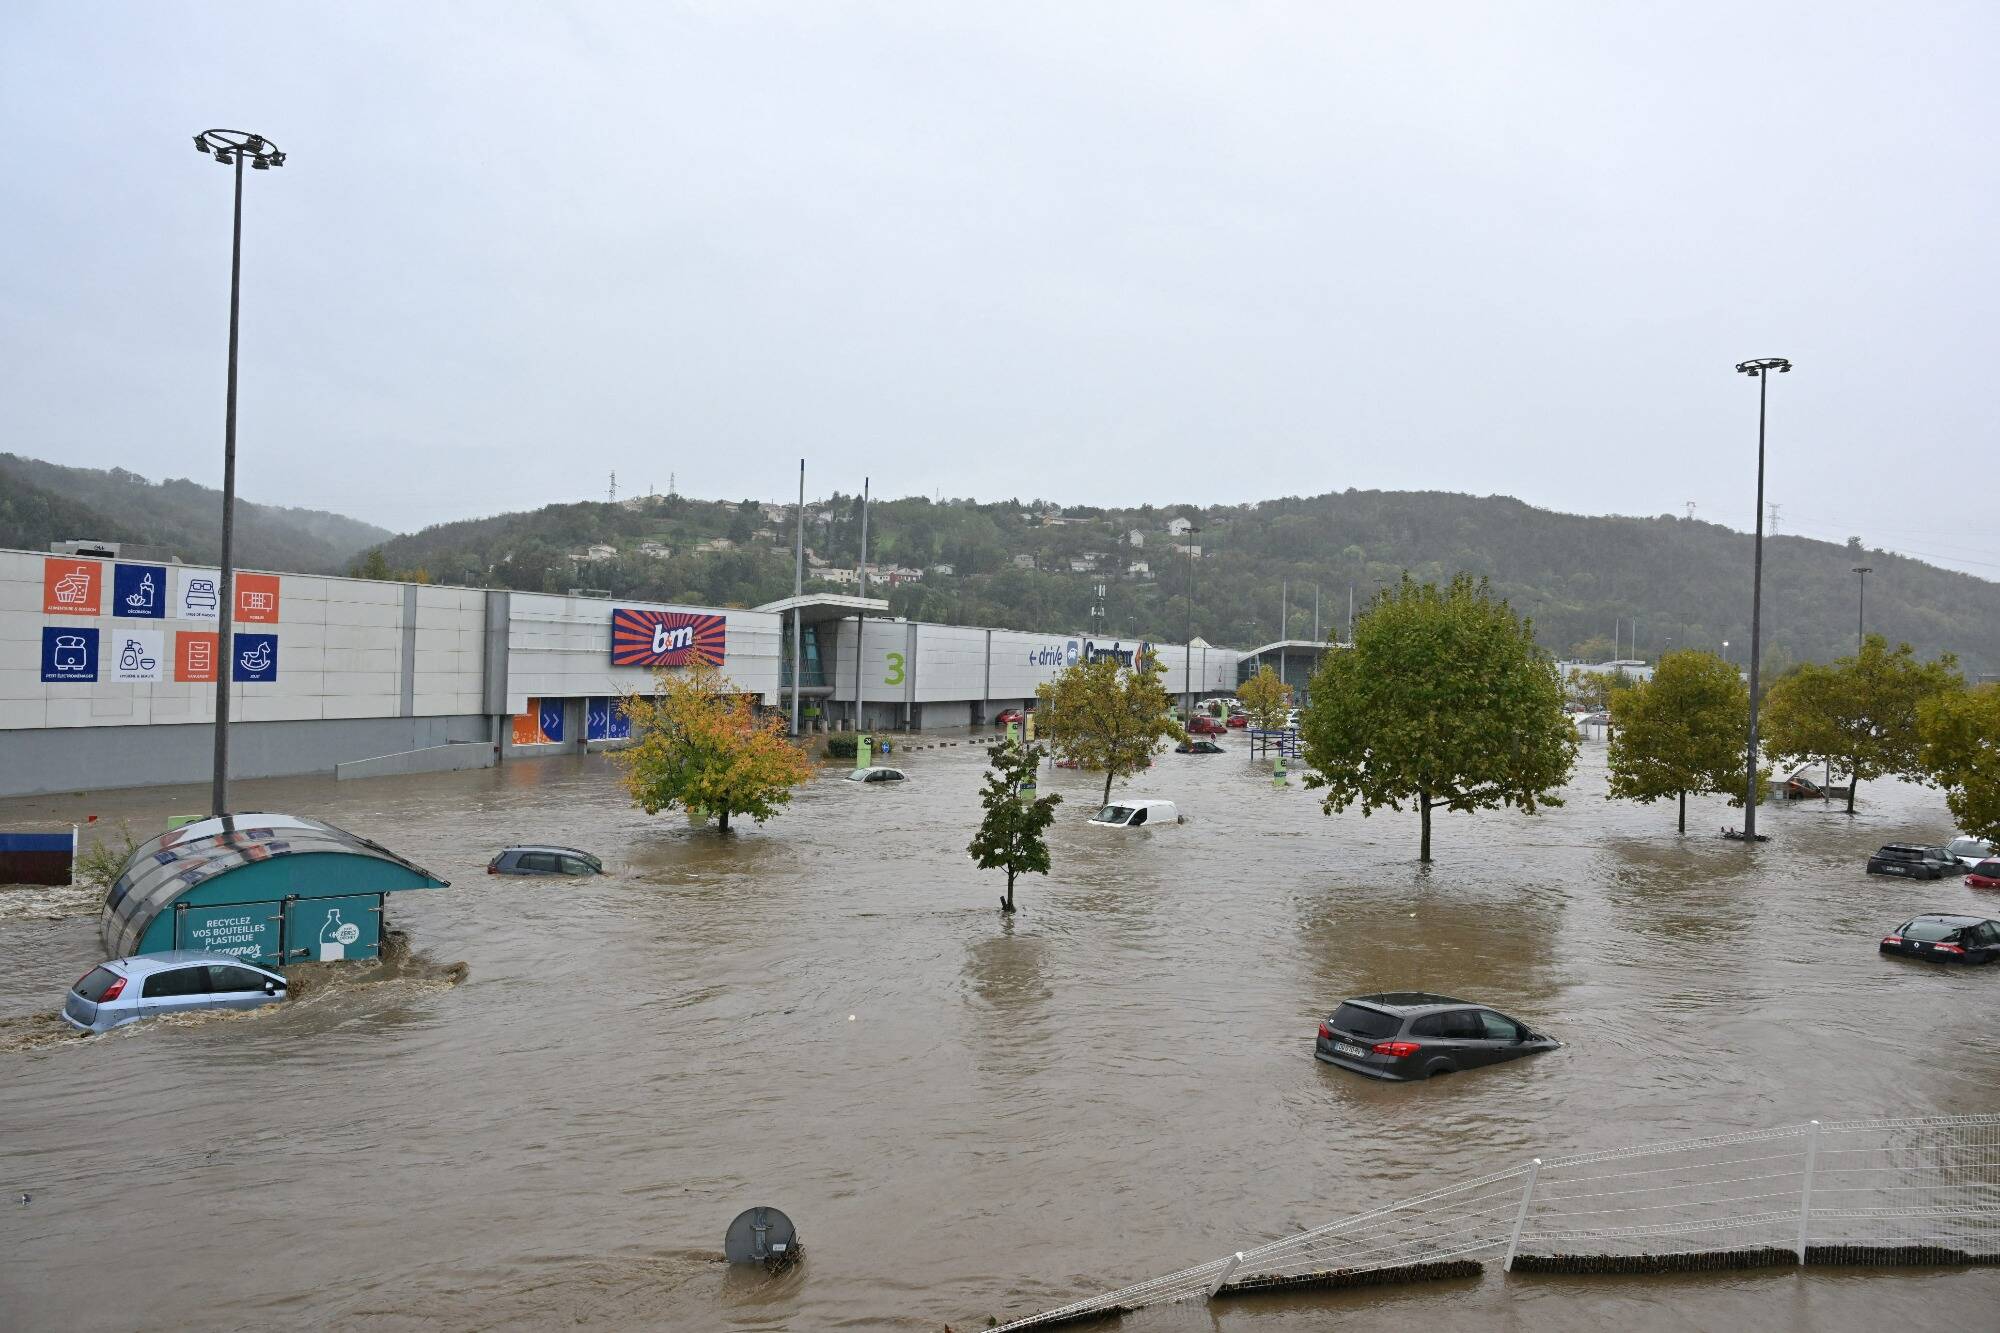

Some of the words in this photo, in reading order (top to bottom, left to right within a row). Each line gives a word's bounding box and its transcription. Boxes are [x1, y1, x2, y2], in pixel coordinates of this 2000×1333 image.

[1039, 645, 1063, 667] drive
[885, 652, 905, 685] 3
[206, 916, 251, 928] RECYCLEZ
[192, 929, 211, 938] VOS
[213, 924, 266, 936] BOUTEILLES
[205, 934, 254, 946] PLASTIQUE
